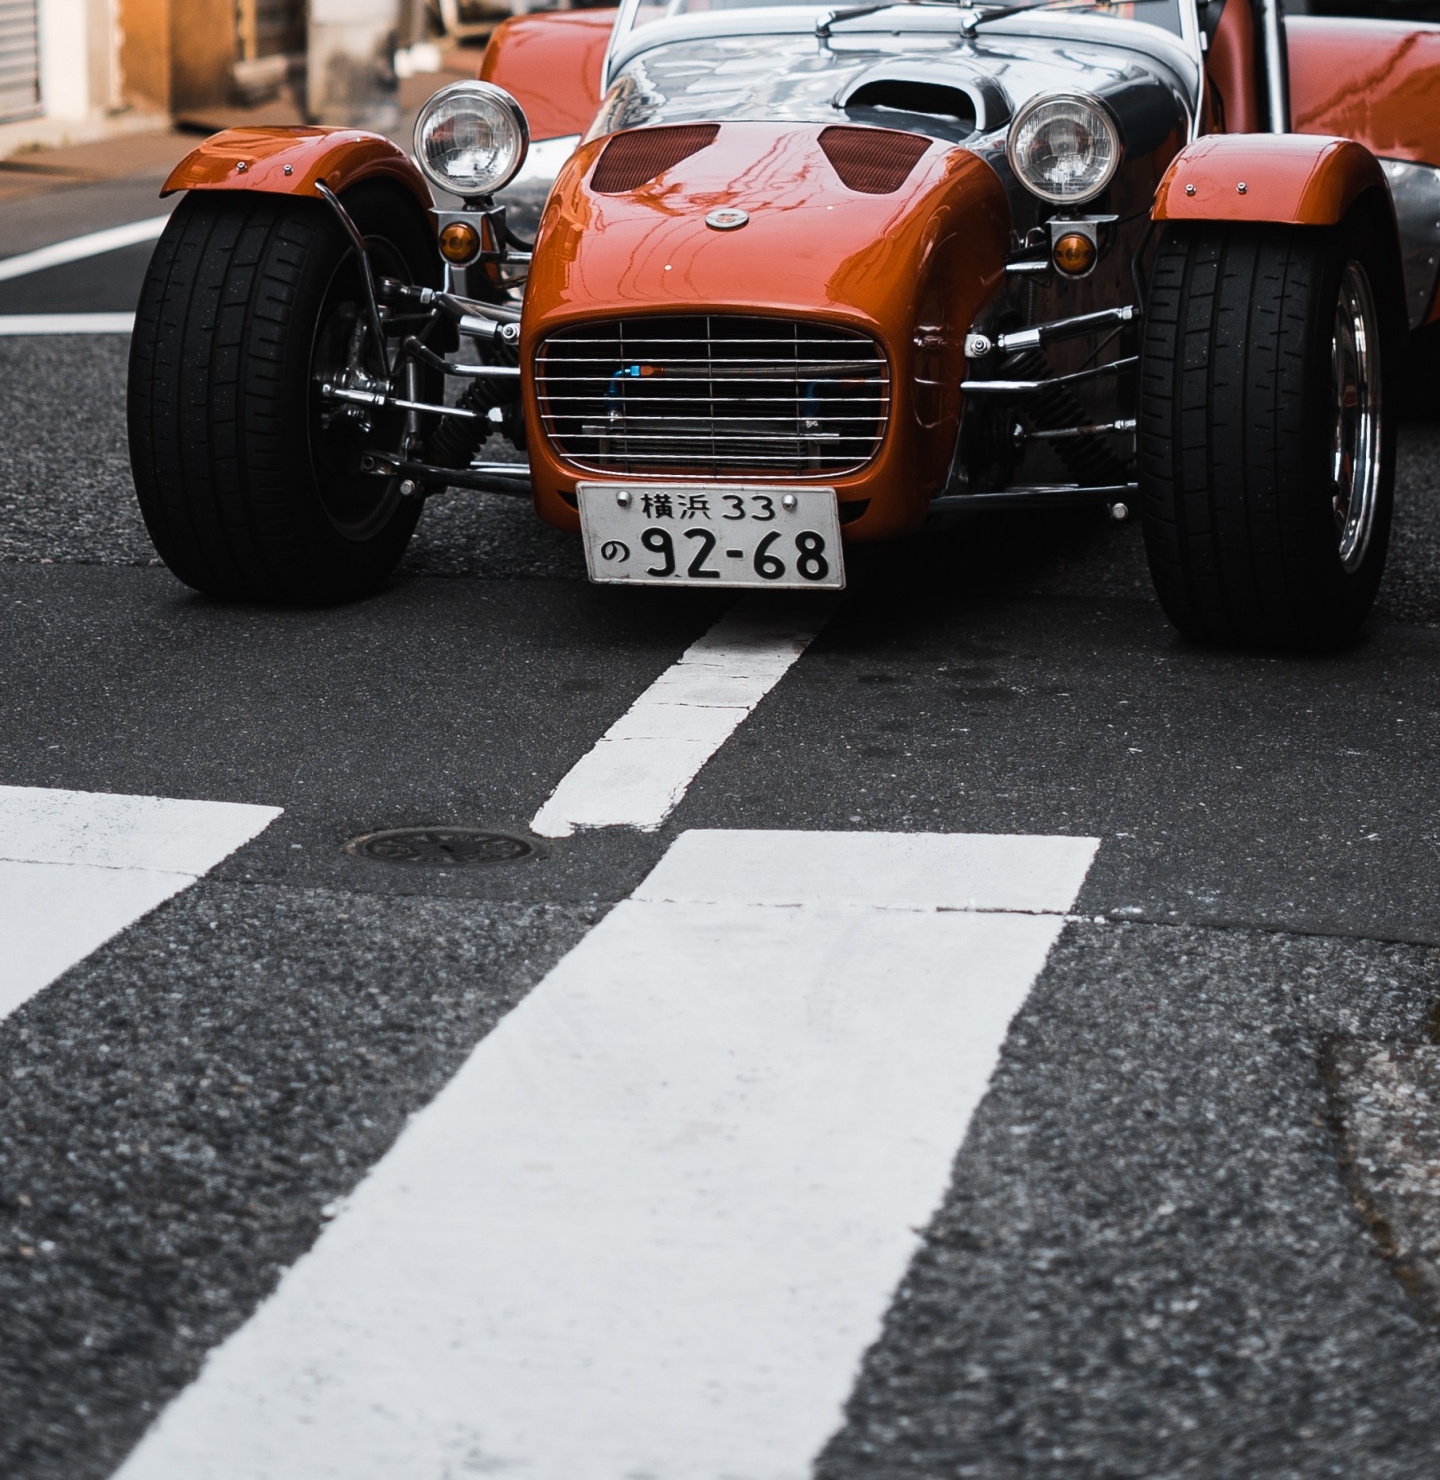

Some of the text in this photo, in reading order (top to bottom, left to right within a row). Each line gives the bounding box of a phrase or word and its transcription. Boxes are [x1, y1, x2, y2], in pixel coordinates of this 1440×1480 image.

[641, 493, 776, 521] 横浜 33
[600, 526, 829, 580] の 92-68
